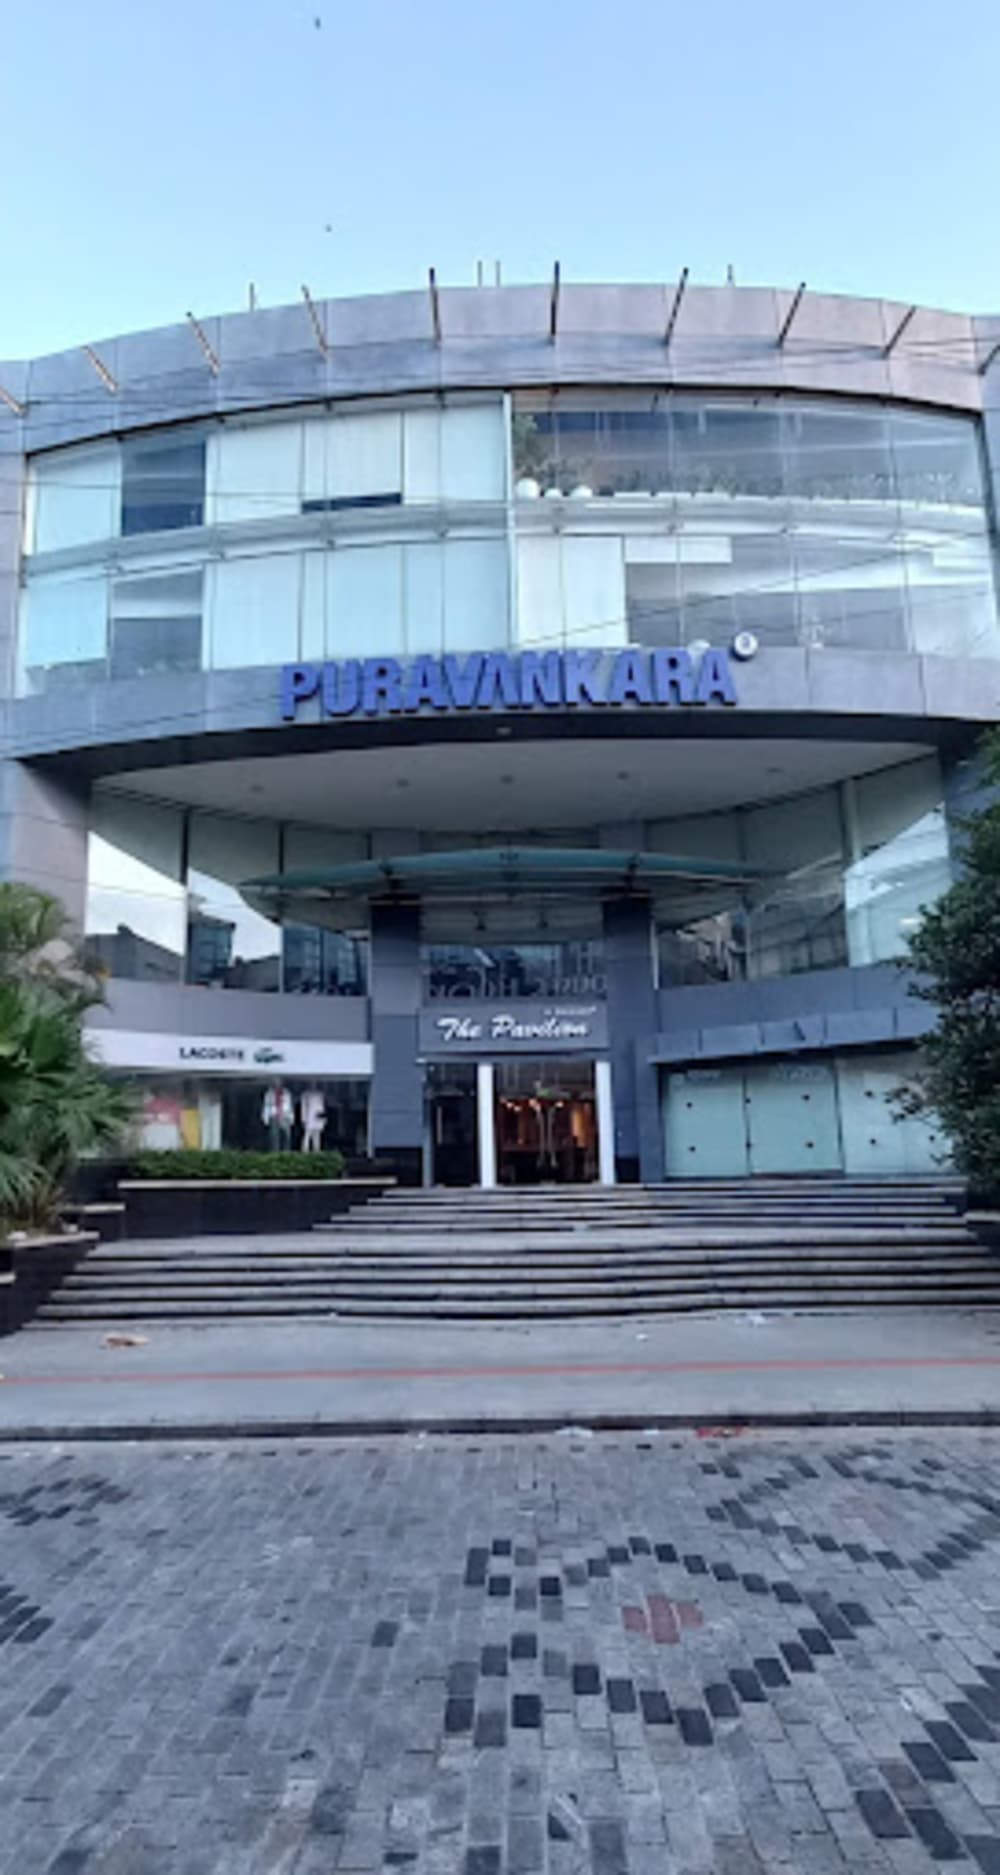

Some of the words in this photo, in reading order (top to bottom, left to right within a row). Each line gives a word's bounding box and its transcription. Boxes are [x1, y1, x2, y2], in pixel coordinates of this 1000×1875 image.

[280, 649, 737, 719] PURAVANKARA
[436, 1016, 482, 1041] The
[491, 1014, 590, 1038] Pavilion
